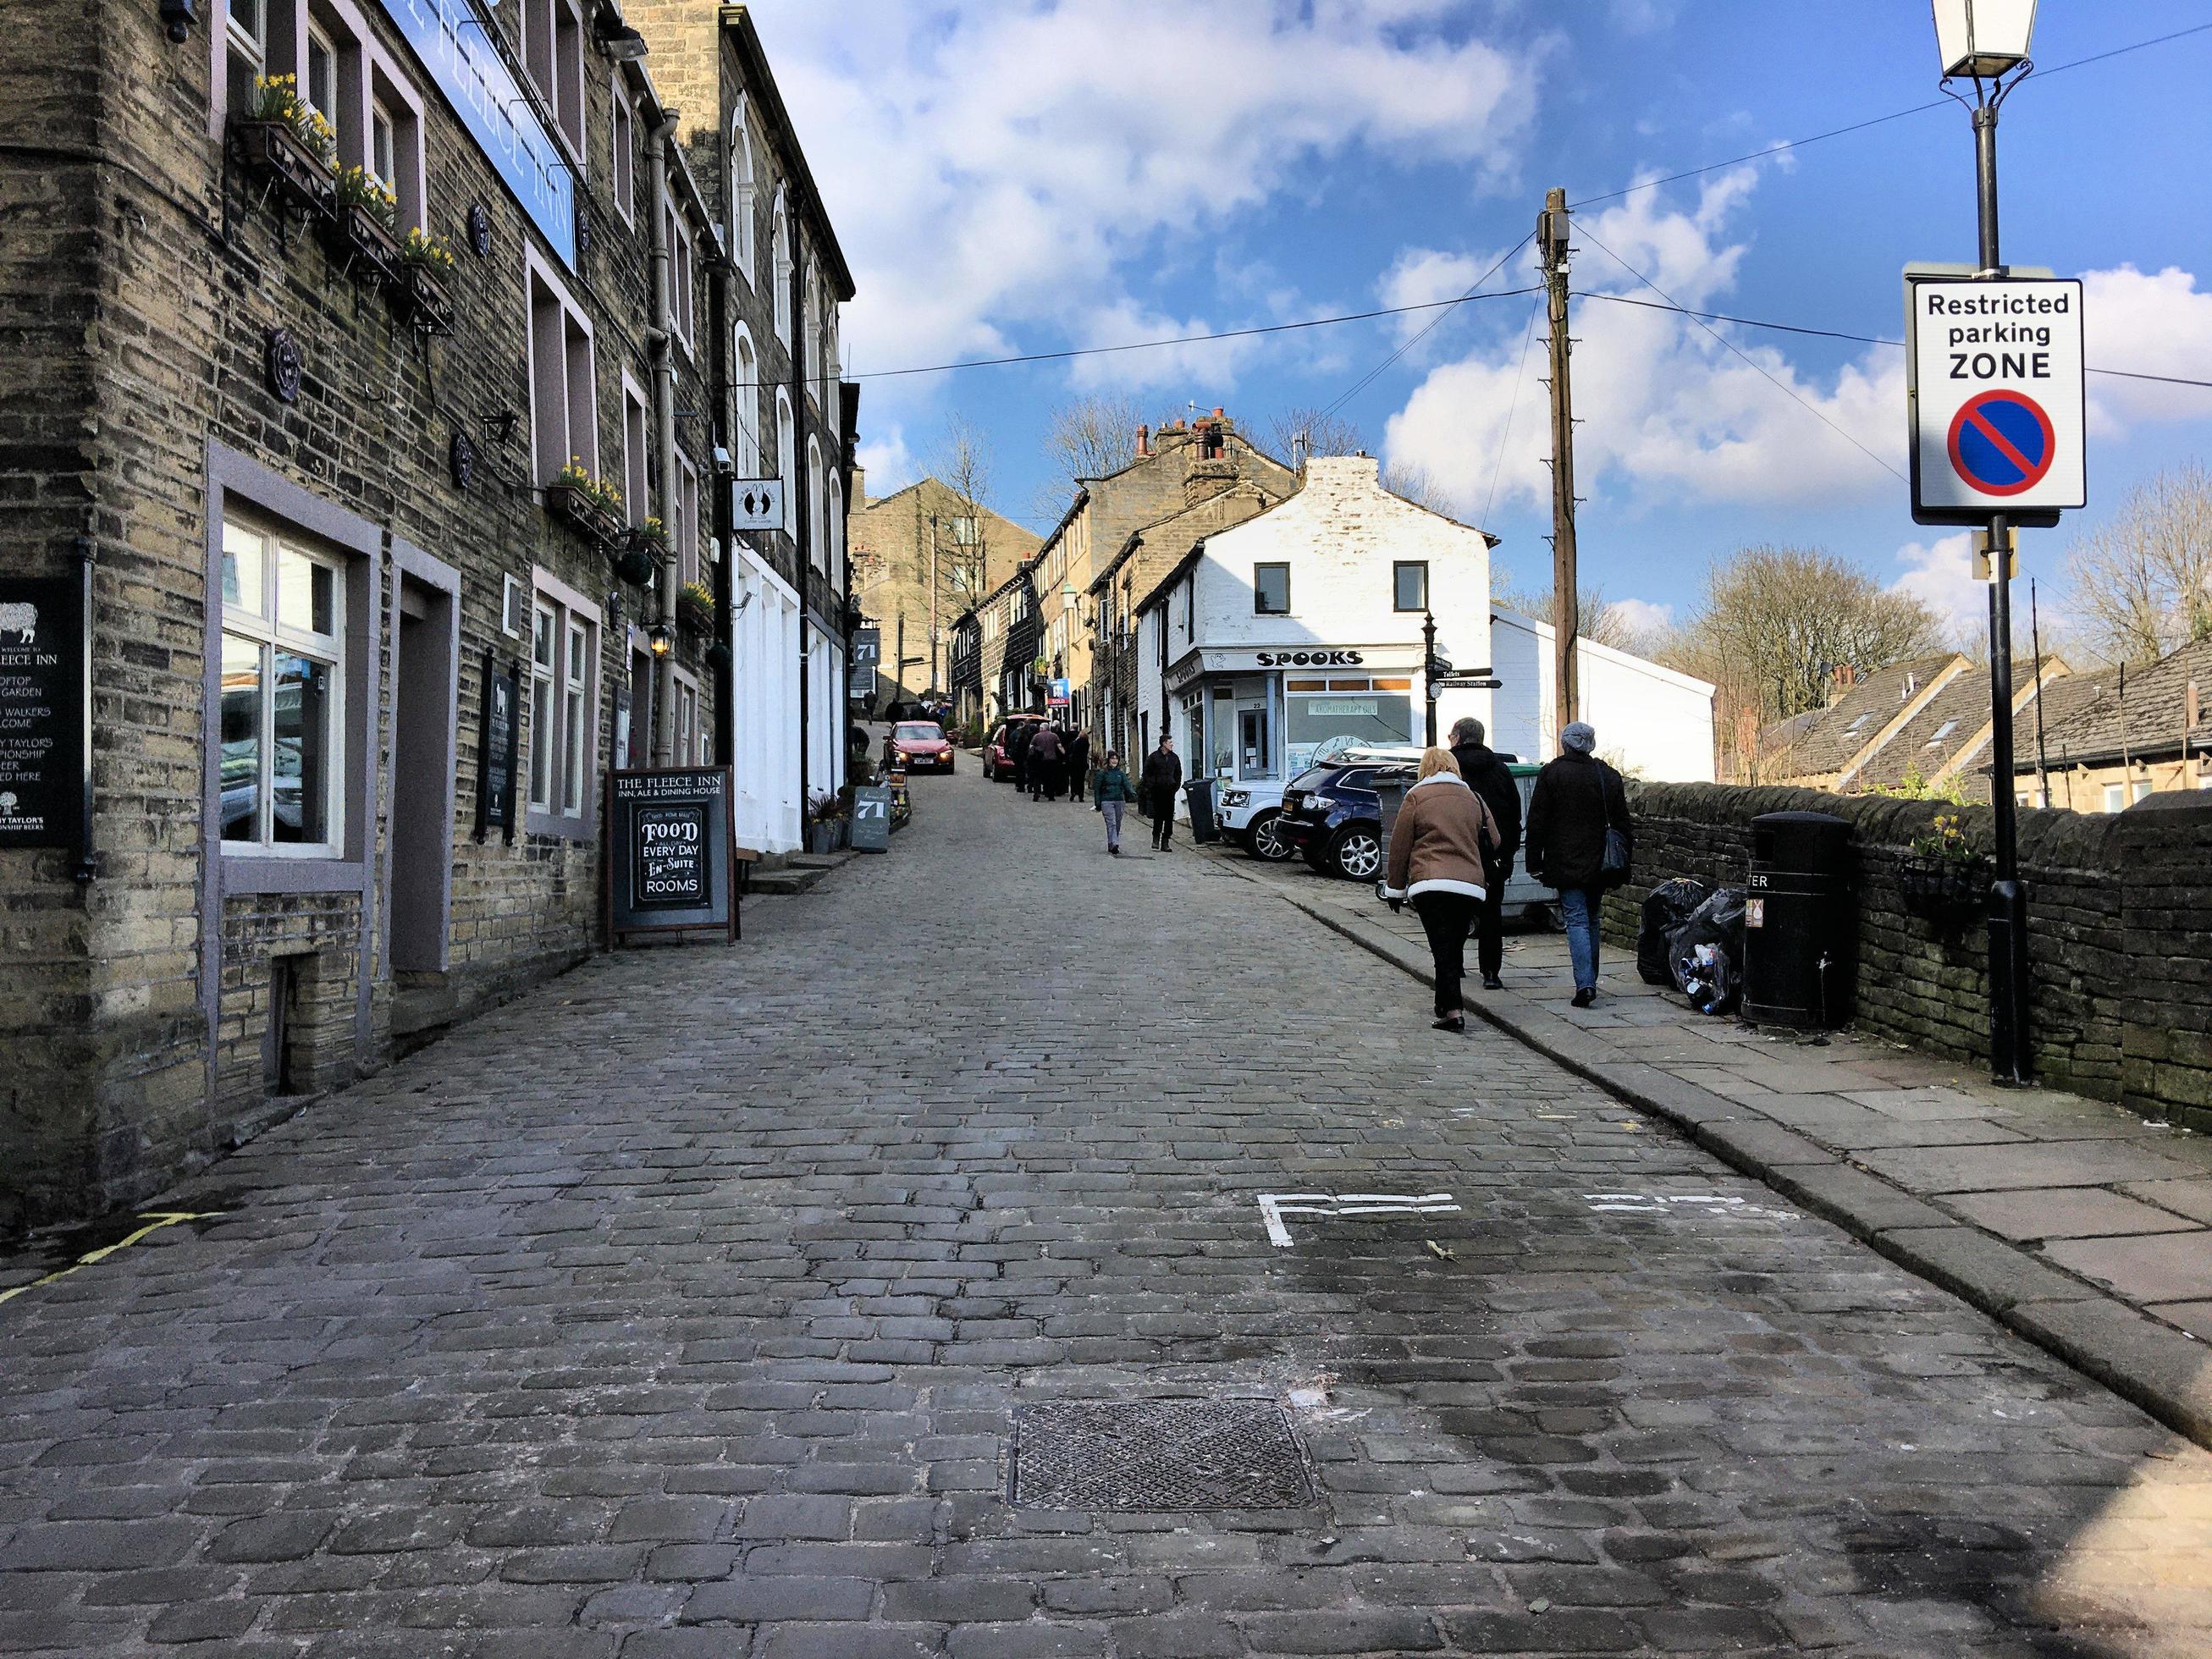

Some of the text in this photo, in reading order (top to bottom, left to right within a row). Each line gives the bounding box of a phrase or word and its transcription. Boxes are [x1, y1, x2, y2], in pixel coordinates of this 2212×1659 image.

[532, 141, 568, 241] INN
[1928, 293, 2069, 315] Restricted
[1950, 322, 2051, 347] parking
[1950, 352, 2051, 379] ZONE
[857, 644, 876, 660] 71
[1256, 651, 1364, 667] SPOOKS
[0, 654, 58, 666] EECE INN
[0, 676, 31, 686] OFTOP
[2, 687, 42, 697] GARDEN
[5, 707, 52, 717] WALKERS
[0, 719, 31, 728] COME
[0, 750, 46, 759] PIONSHIP
[0, 762, 20, 771] EER
[16, 772, 41, 781] HERE
[617, 775, 721, 789] THE FLEECE INN
[858, 800, 885, 819] 71
[642, 822, 698, 845] FOOD
[643, 845, 699, 857] EVERY DAY
[647, 879, 698, 893] ROOMS
